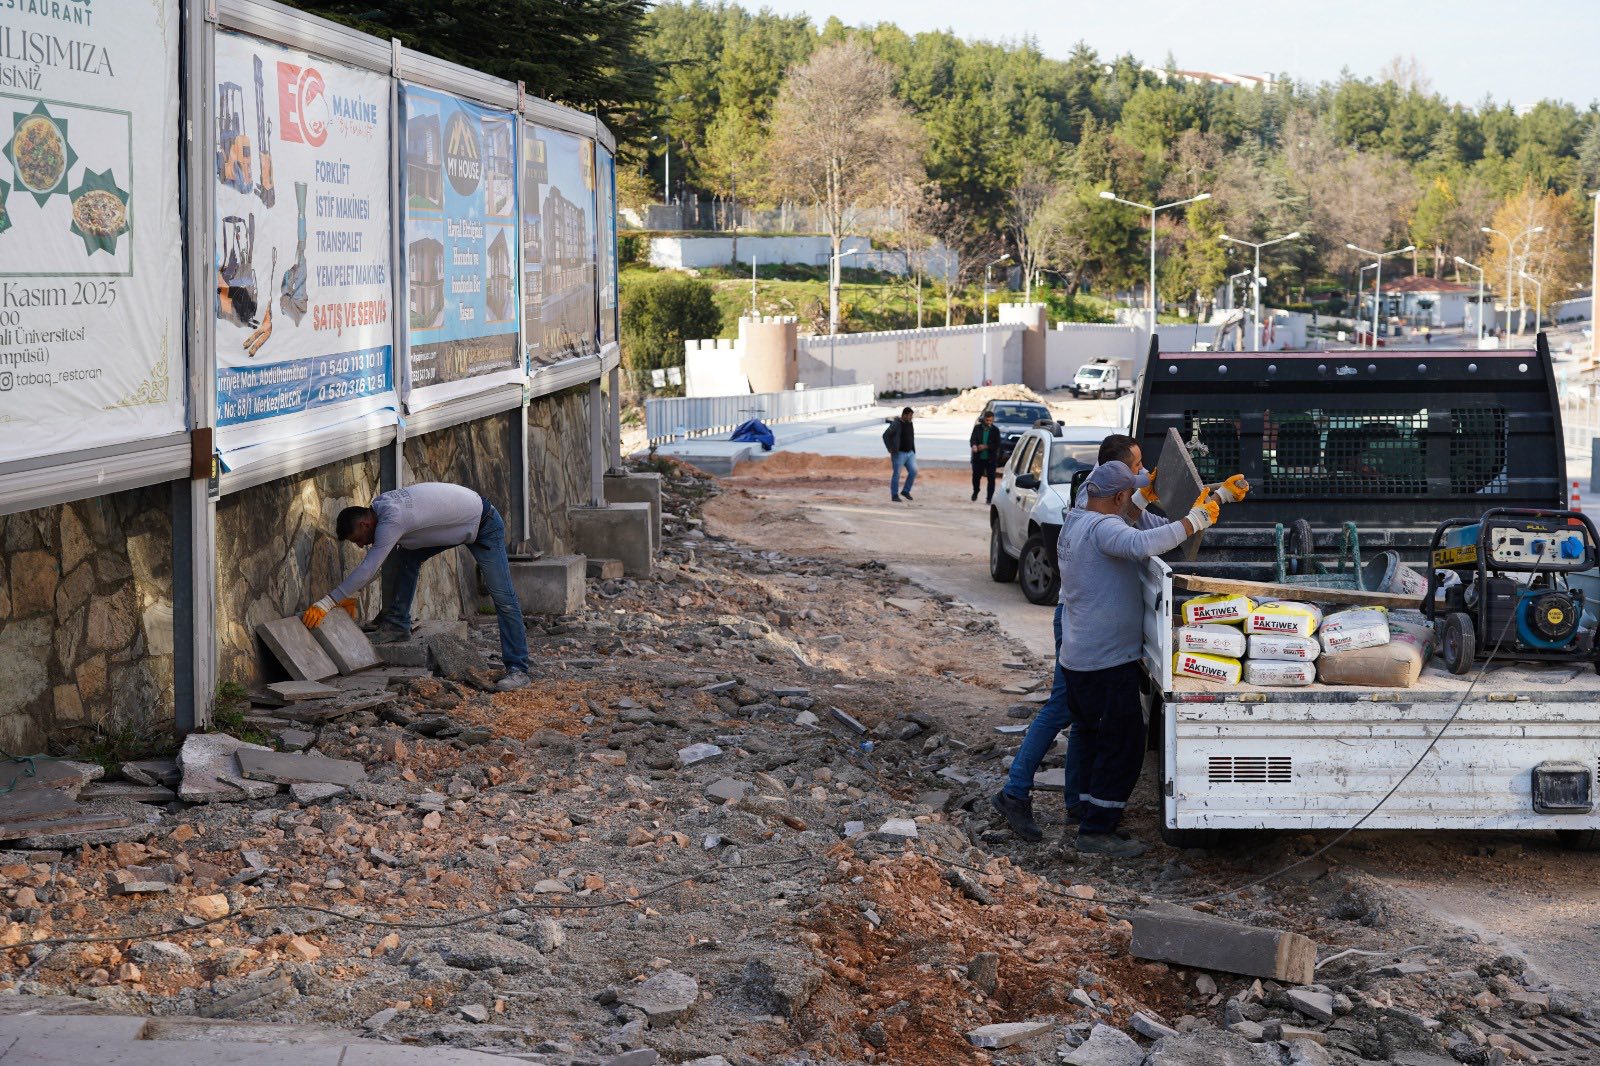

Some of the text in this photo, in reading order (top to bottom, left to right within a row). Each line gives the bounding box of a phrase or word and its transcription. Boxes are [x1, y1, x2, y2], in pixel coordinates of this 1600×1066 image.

[0, 0, 92, 26] STAURANT
[332, 94, 377, 125] MAKİNE
[315, 158, 350, 185] FORKLİFT
[447, 157, 479, 181] MY HOUSE
[315, 190, 370, 220] İSTİF MAKİNESİ
[316, 231, 362, 253] TRANSPALET
[316, 265, 333, 287] YEM
[334, 265, 354, 286] PELET
[3, 279, 117, 309] Kasım 2025
[313, 294, 386, 337] SATIŞ VE SERVİS
[15, 326, 85, 345] Üniversitesi
[320, 351, 384, 377] 0 540 113 10 11
[897, 339, 939, 363] BİLECİK
[318, 385, 325, 401] 0
[328, 382, 347, 400] 530
[367, 376, 376, 391] 12
[377, 374, 386, 388] 51
[1434, 551, 1455, 566] FULL
